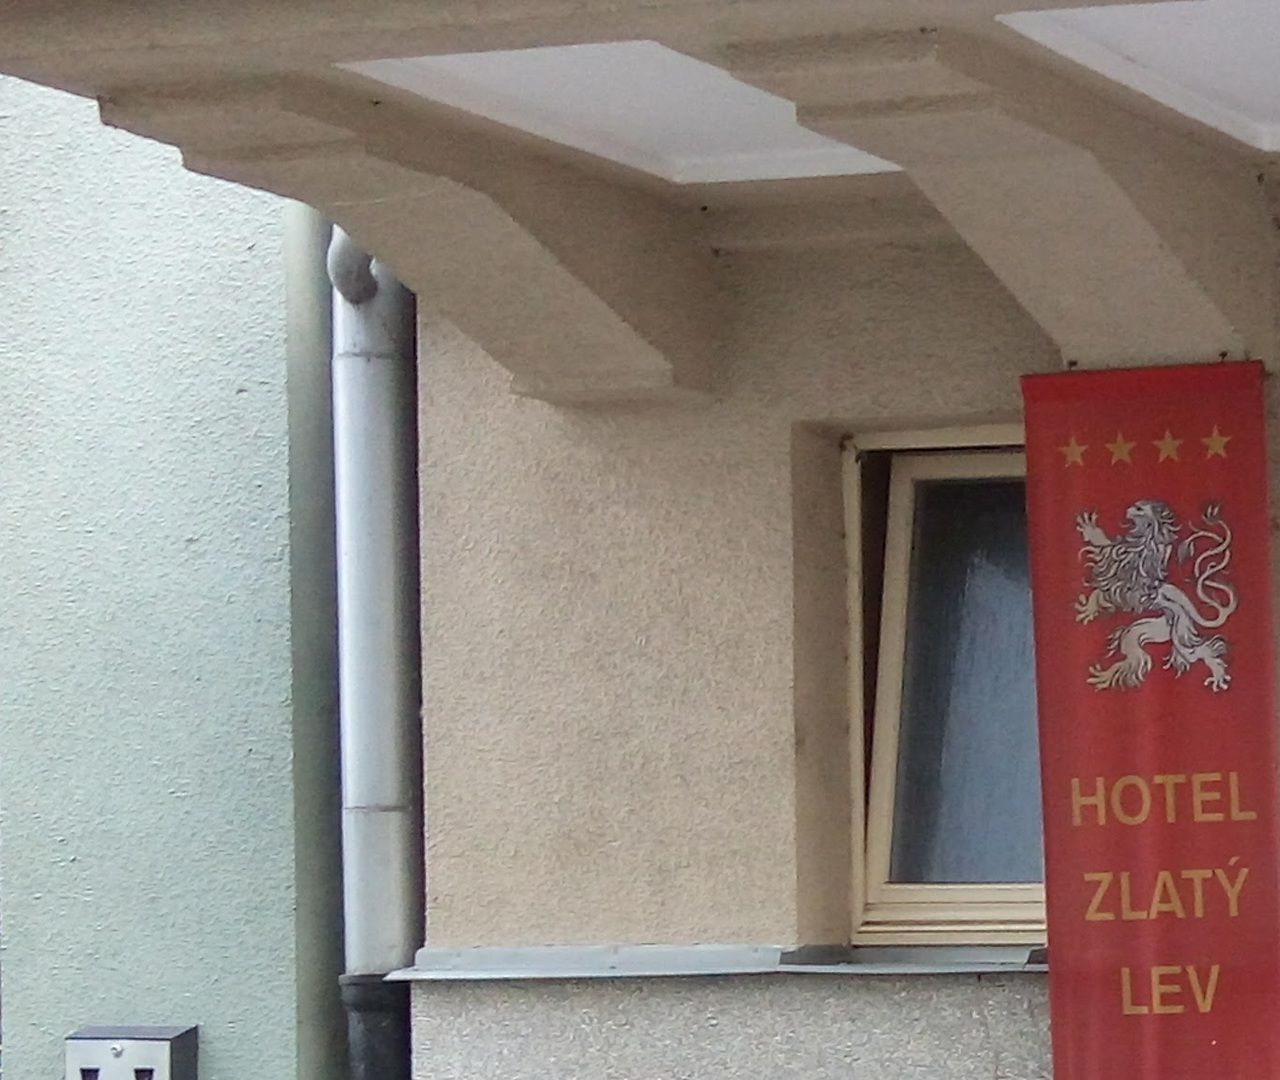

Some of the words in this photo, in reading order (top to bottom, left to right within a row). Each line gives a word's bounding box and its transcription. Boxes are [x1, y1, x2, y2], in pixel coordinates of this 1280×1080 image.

[1071, 772, 1257, 826] HOTEL
[1084, 857, 1249, 921] ZLATÝ
[1121, 965, 1221, 1015] LEV
